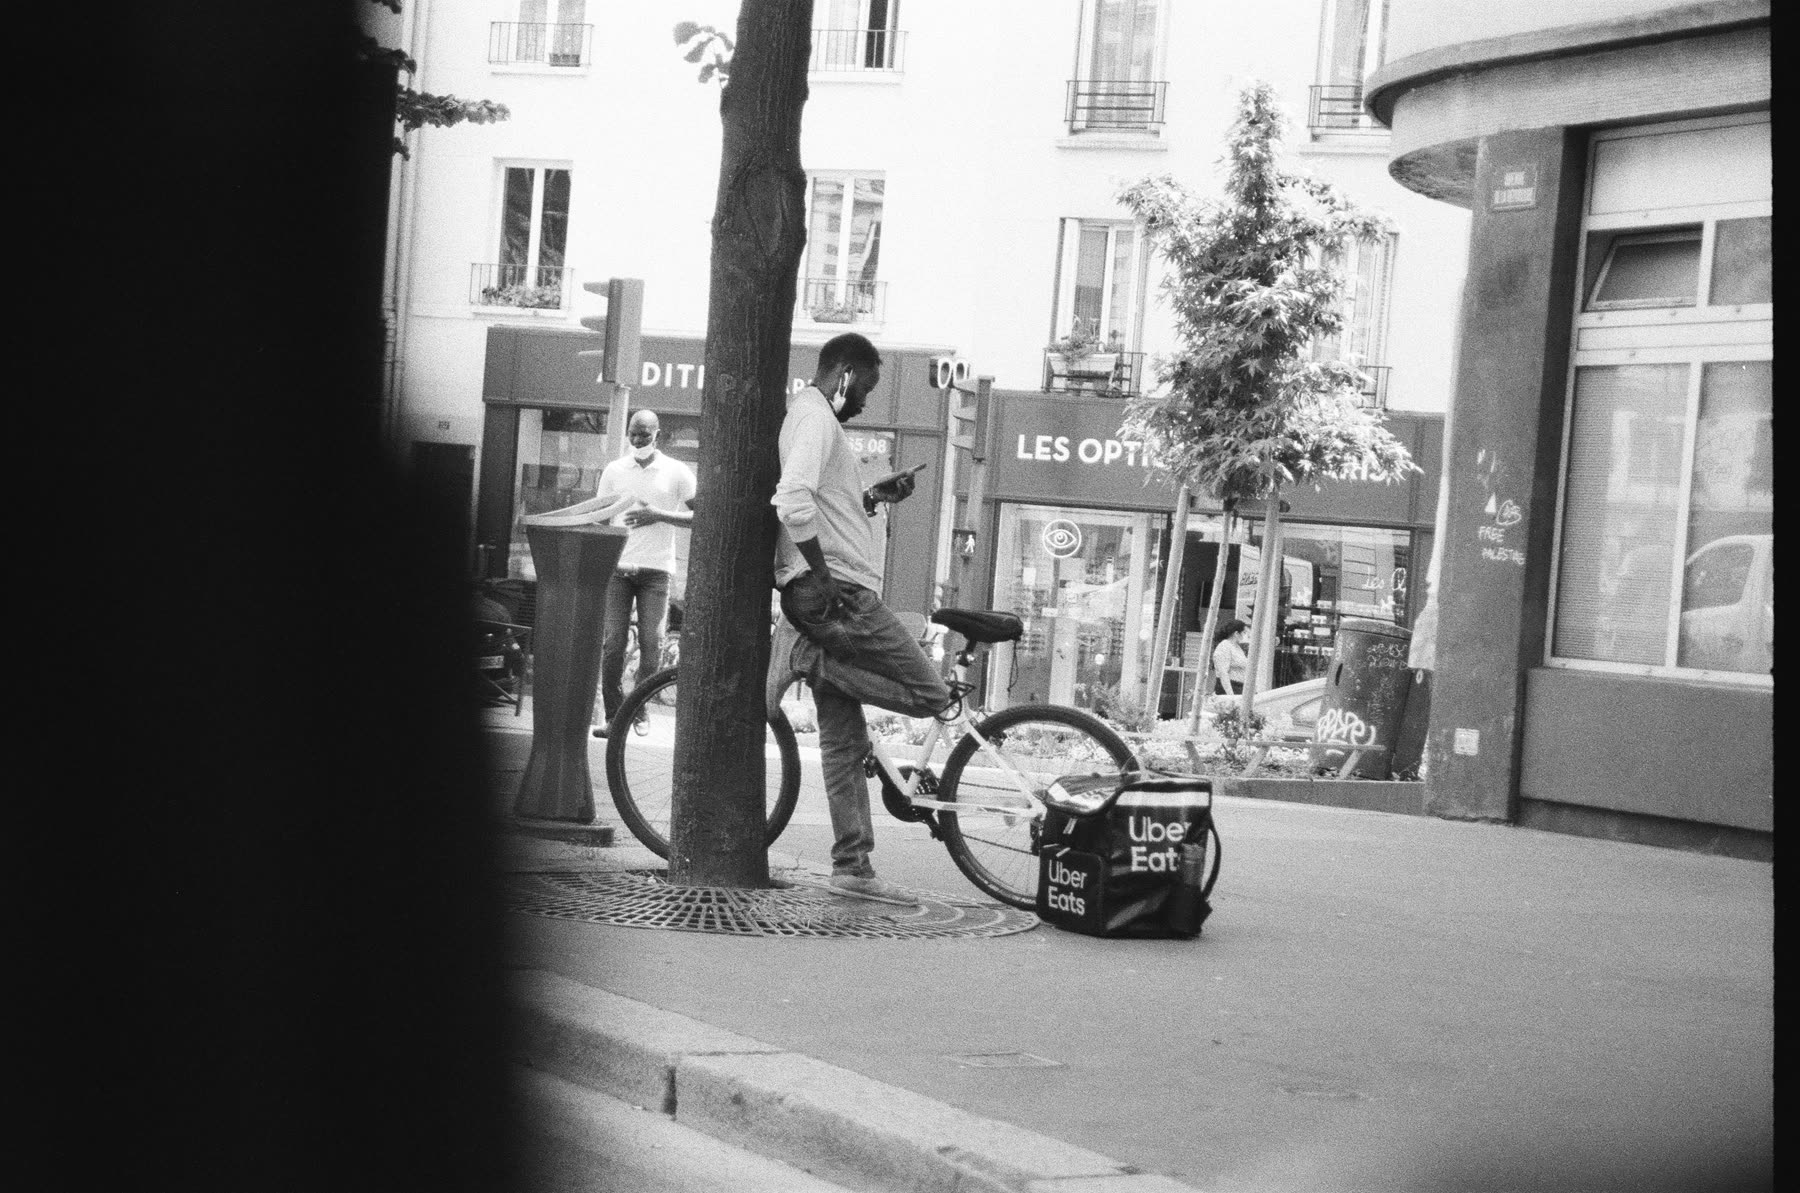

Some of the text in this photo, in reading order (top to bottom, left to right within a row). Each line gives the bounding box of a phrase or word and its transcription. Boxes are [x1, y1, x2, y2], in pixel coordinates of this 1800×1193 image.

[868, 438, 887, 453] 08
[1017, 434, 1149, 467] LES OPTI
[1478, 526, 1504, 542] FREE
[1128, 815, 1192, 842] Uber
[1131, 846, 1181, 872] Eat
[1048, 859, 1087, 889] Uber
[1047, 885, 1085, 916] Eats
